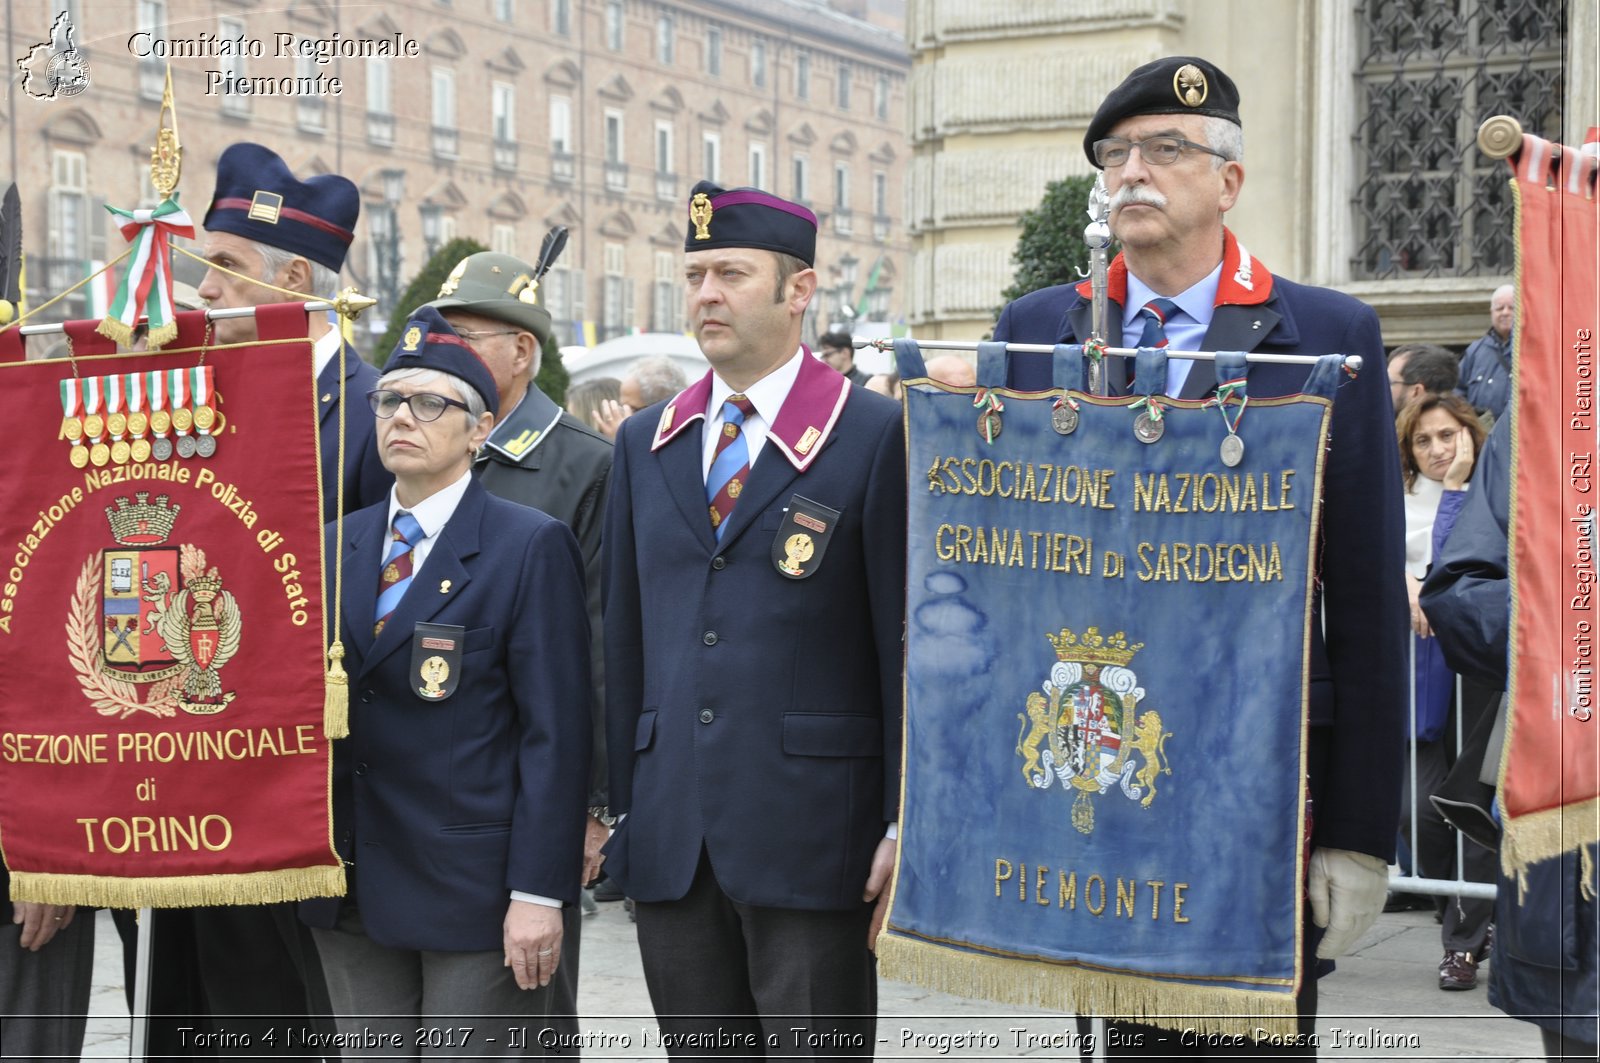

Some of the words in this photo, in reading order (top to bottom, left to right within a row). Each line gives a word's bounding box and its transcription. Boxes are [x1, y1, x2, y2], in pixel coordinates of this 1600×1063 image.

[927, 456, 1116, 510] ASSOCIAZIONE
[1133, 469, 1296, 513] NAZIONALE
[0, 485, 83, 634] Associazione
[84, 460, 191, 494] Nazionale
[194, 467, 258, 530] Polizia
[256, 528, 285, 553] di
[273, 552, 309, 627] Stato
[934, 523, 1094, 576] GRANATIERI
[1136, 541, 1284, 583] SARDEGNA
[2, 732, 108, 764] SEZIONE
[117, 724, 318, 763] PROVINCIALE
[135, 777, 157, 802] di
[76, 814, 233, 854] TORINO
[994, 857, 1190, 923] PIEMONTE
